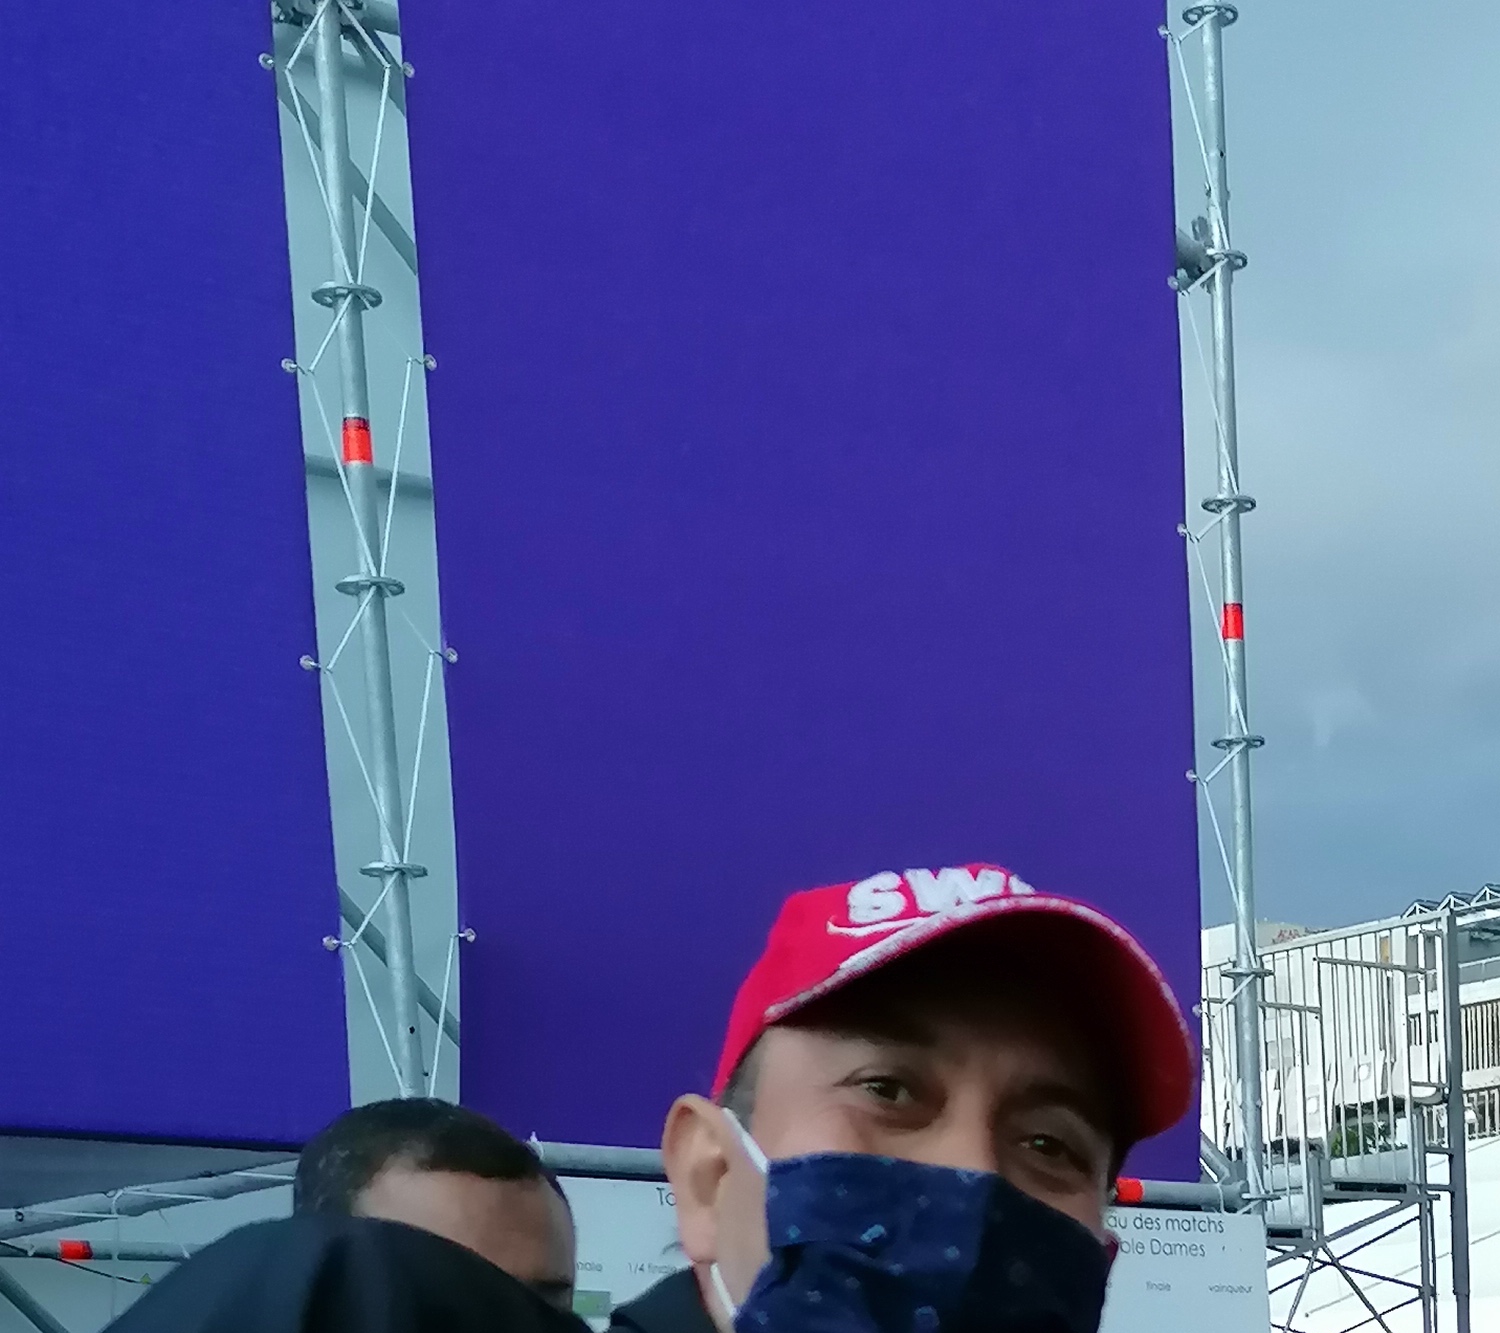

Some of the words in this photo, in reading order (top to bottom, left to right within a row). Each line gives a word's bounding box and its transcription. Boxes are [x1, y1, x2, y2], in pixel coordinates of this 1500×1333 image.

[846, 866, 1036, 924] SW
[1132, 1212, 1162, 1231] des
[1165, 1215, 1225, 1233] matchs
[1150, 1238, 1206, 1258] Dames
